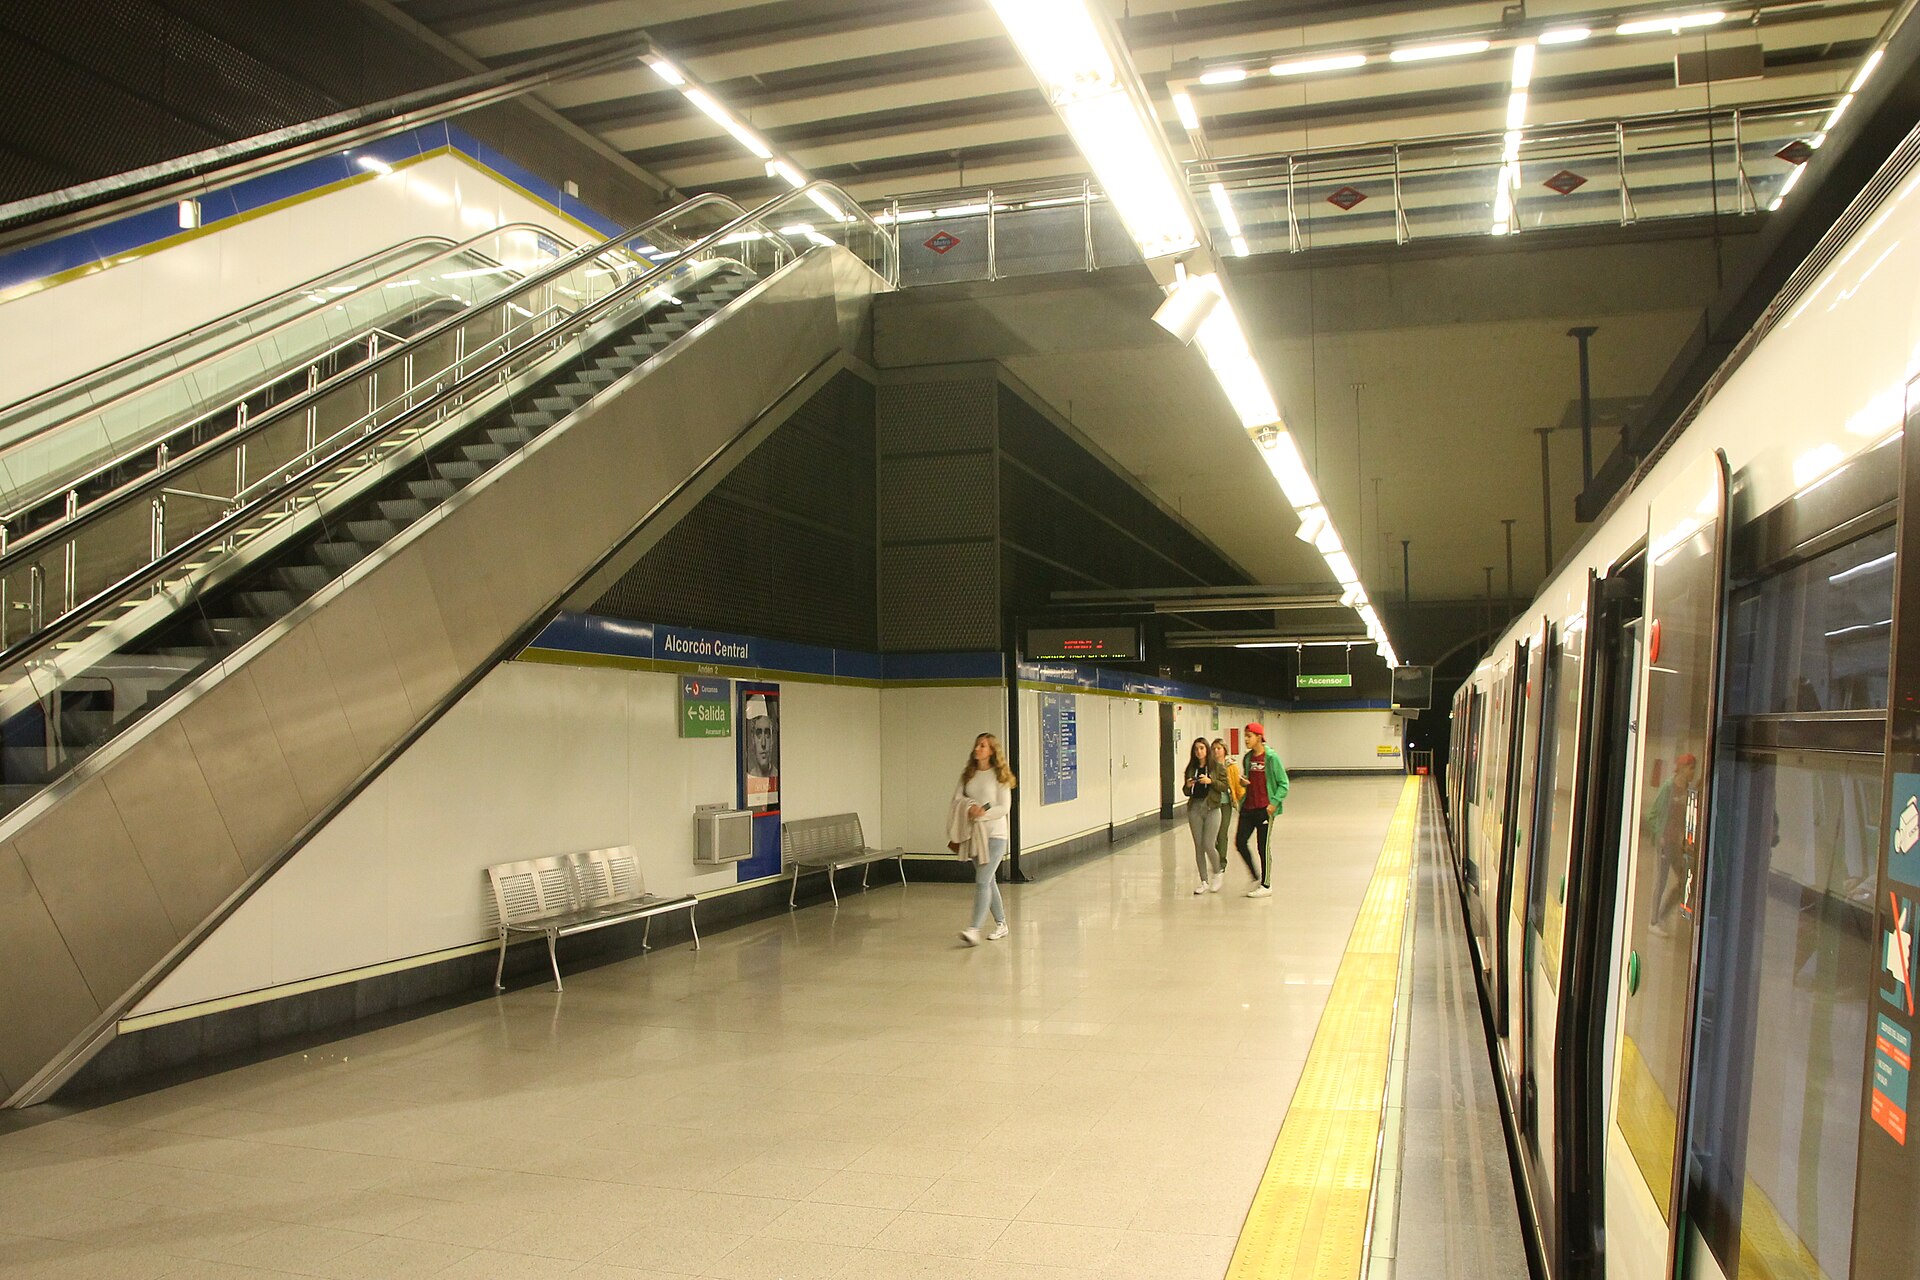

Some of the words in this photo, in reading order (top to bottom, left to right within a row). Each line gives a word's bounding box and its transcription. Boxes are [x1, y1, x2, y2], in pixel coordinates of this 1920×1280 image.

[664, 634, 712, 655] Alcorcón
[714, 640, 749, 659] Central
[1308, 677, 1343, 685] Ascensor
[698, 704, 725, 721] Salida
